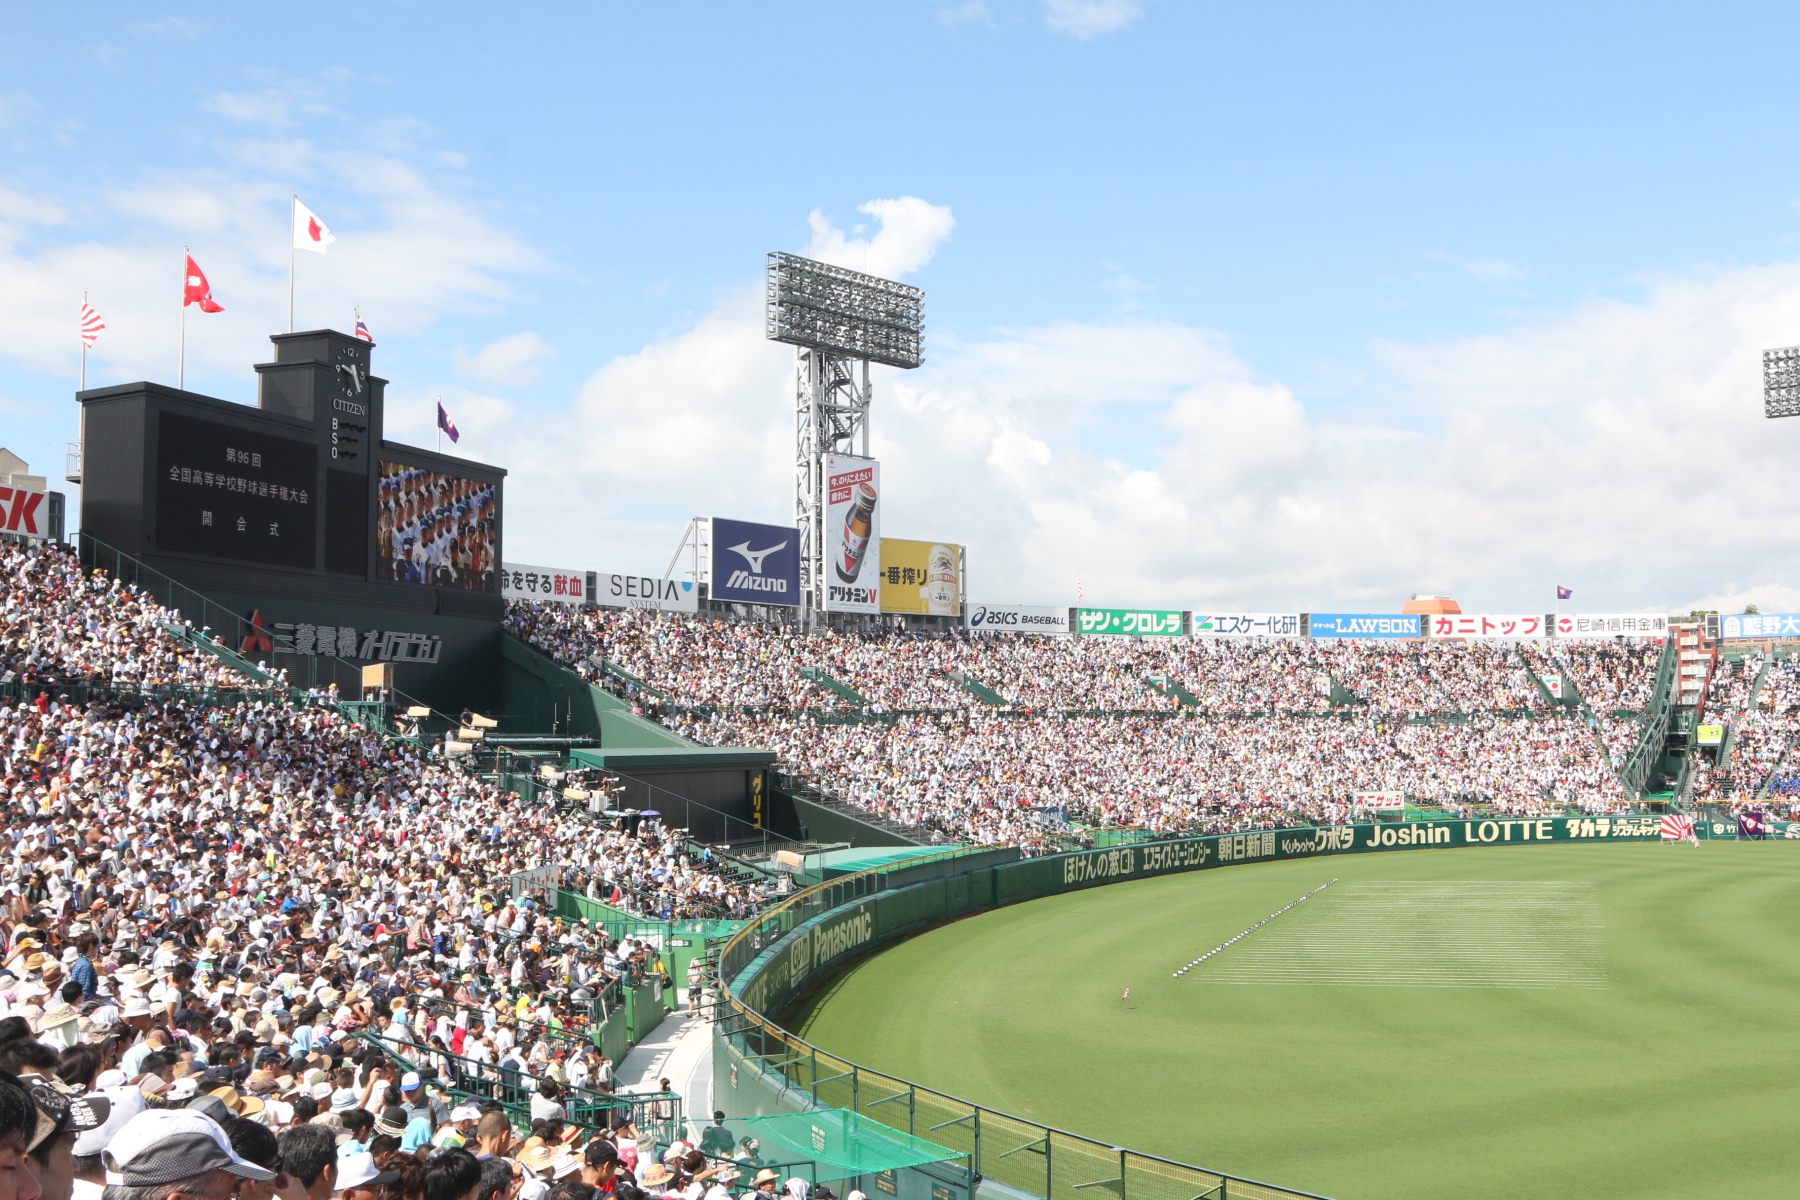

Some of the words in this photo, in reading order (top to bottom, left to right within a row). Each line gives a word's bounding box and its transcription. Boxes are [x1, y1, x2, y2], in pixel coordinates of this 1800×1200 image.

[347, 348, 354, 357] 12
[335, 364, 341, 373] 9
[360, 371, 365, 380] 3
[346, 388, 353, 397] 6
[333, 398, 365, 416] CITIZEN
[332, 417, 338, 430] B
[331, 432, 338, 444] S
[226, 447, 261, 467] 第96回
[169, 465, 308, 504] 全国高等学校野球選手権大会
[202, 510, 212, 526] 開
[236, 516, 246, 531] 会
[269, 522, 279, 537] 式
[630, 599, 661, 610] SYSTEM
[829, 586, 877, 604] アリナミンV
[1021, 615, 1065, 625] BASEBALL
[1080, 611, 1181, 632] サン・クロレラ
[1214, 615, 1297, 634] エスケー化研
[1336, 618, 1417, 633] LAWSON
[1435, 616, 1540, 635] カニトップ
[1576, 617, 1666, 632] 尼崎信用金庫
[1743, 616, 1800, 635] 藍野大
[274, 623, 357, 658] 三菱電機
[752, 774, 762, 829] グリコ
[1366, 823, 1450, 847] Joshin
[1465, 819, 1553, 842] LOTTE
[1565, 818, 1610, 838] タカラ
[1218, 832, 1276, 861] 朝日新聞
[1282, 838, 1315, 854] Kubota
[1315, 827, 1354, 852] クボタ
[1064, 848, 1131, 884] ほけんの窓口
[813, 905, 872, 969] Panasonic
